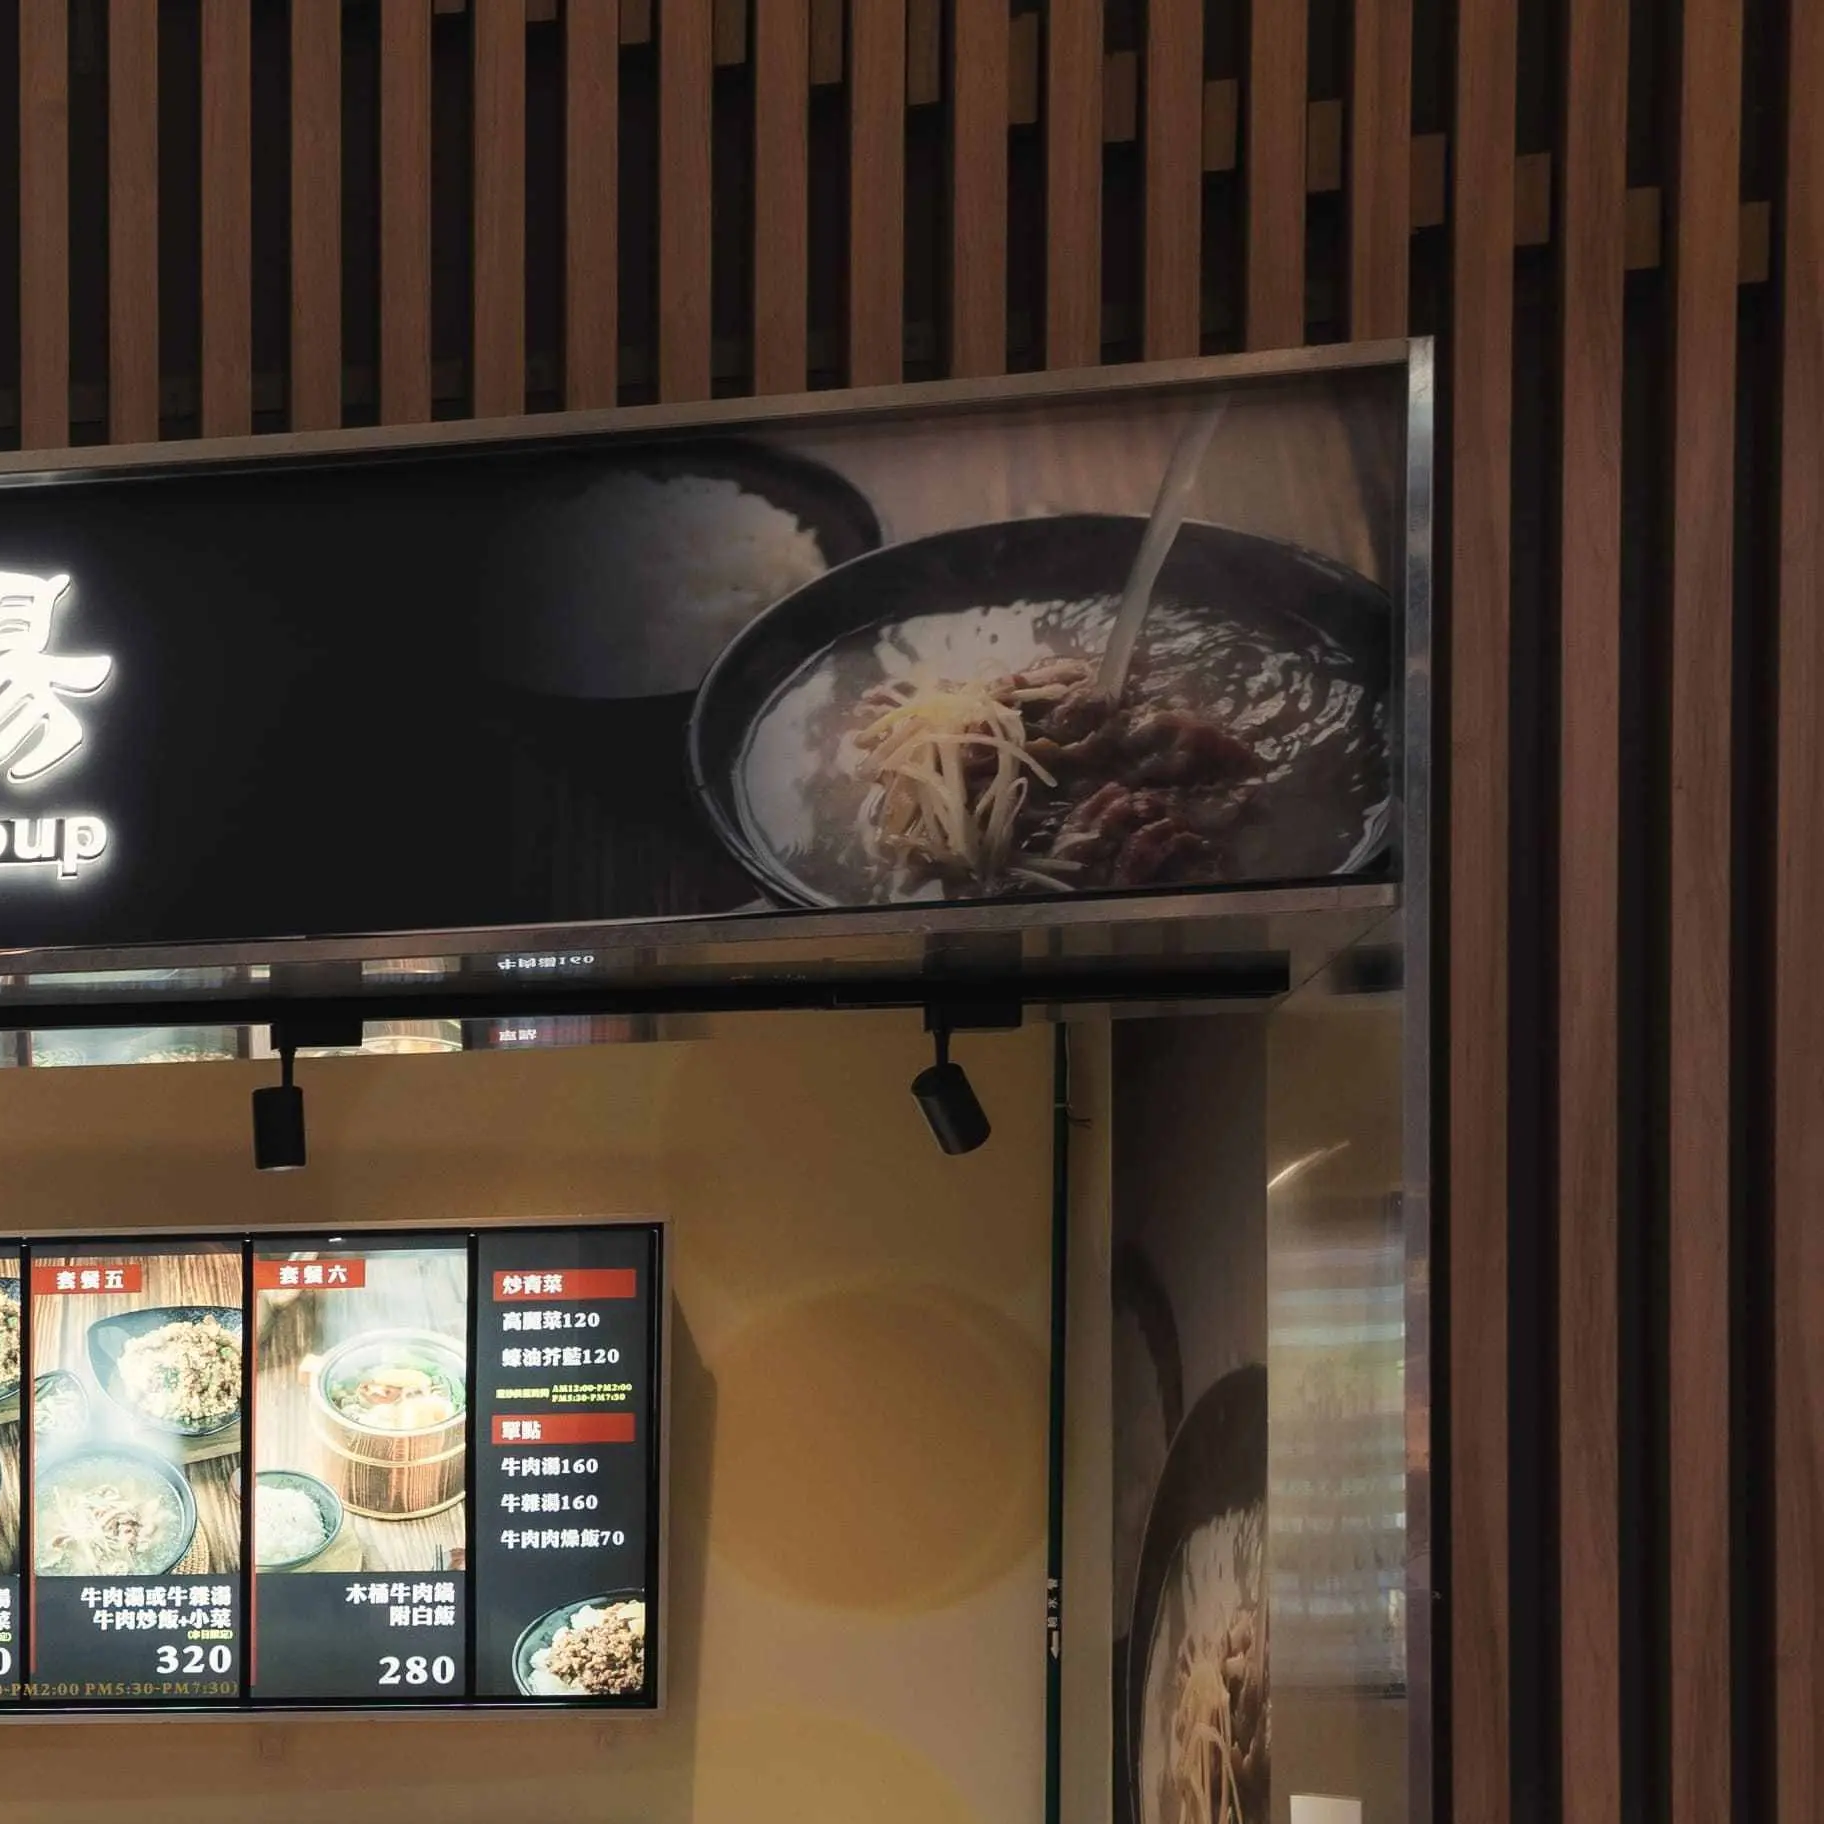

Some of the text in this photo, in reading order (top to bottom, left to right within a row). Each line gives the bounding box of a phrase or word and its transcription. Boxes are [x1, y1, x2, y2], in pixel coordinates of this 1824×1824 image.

[55, 1268, 125, 1291] 套餐五
[279, 1264, 349, 1286] 套餐六
[502, 1274, 564, 1295] 炒青菜
[502, 1311, 601, 1331] 高麗菜120
[501, 1420, 542, 1440] 單點
[501, 1456, 599, 1477] 牛肉湯160
[500, 1492, 598, 1513] 牛雜湯160
[80, 1585, 232, 1609] 牛肉湯或牛雜湯
[345, 1582, 455, 1605] 木桶牛肉鍋
[92, 1608, 232, 1631] 牛肉炒飯+小菜
[389, 1604, 455, 1628] 附白飯
[156, 1644, 232, 1674] 320
[378, 1655, 455, 1686] 280
